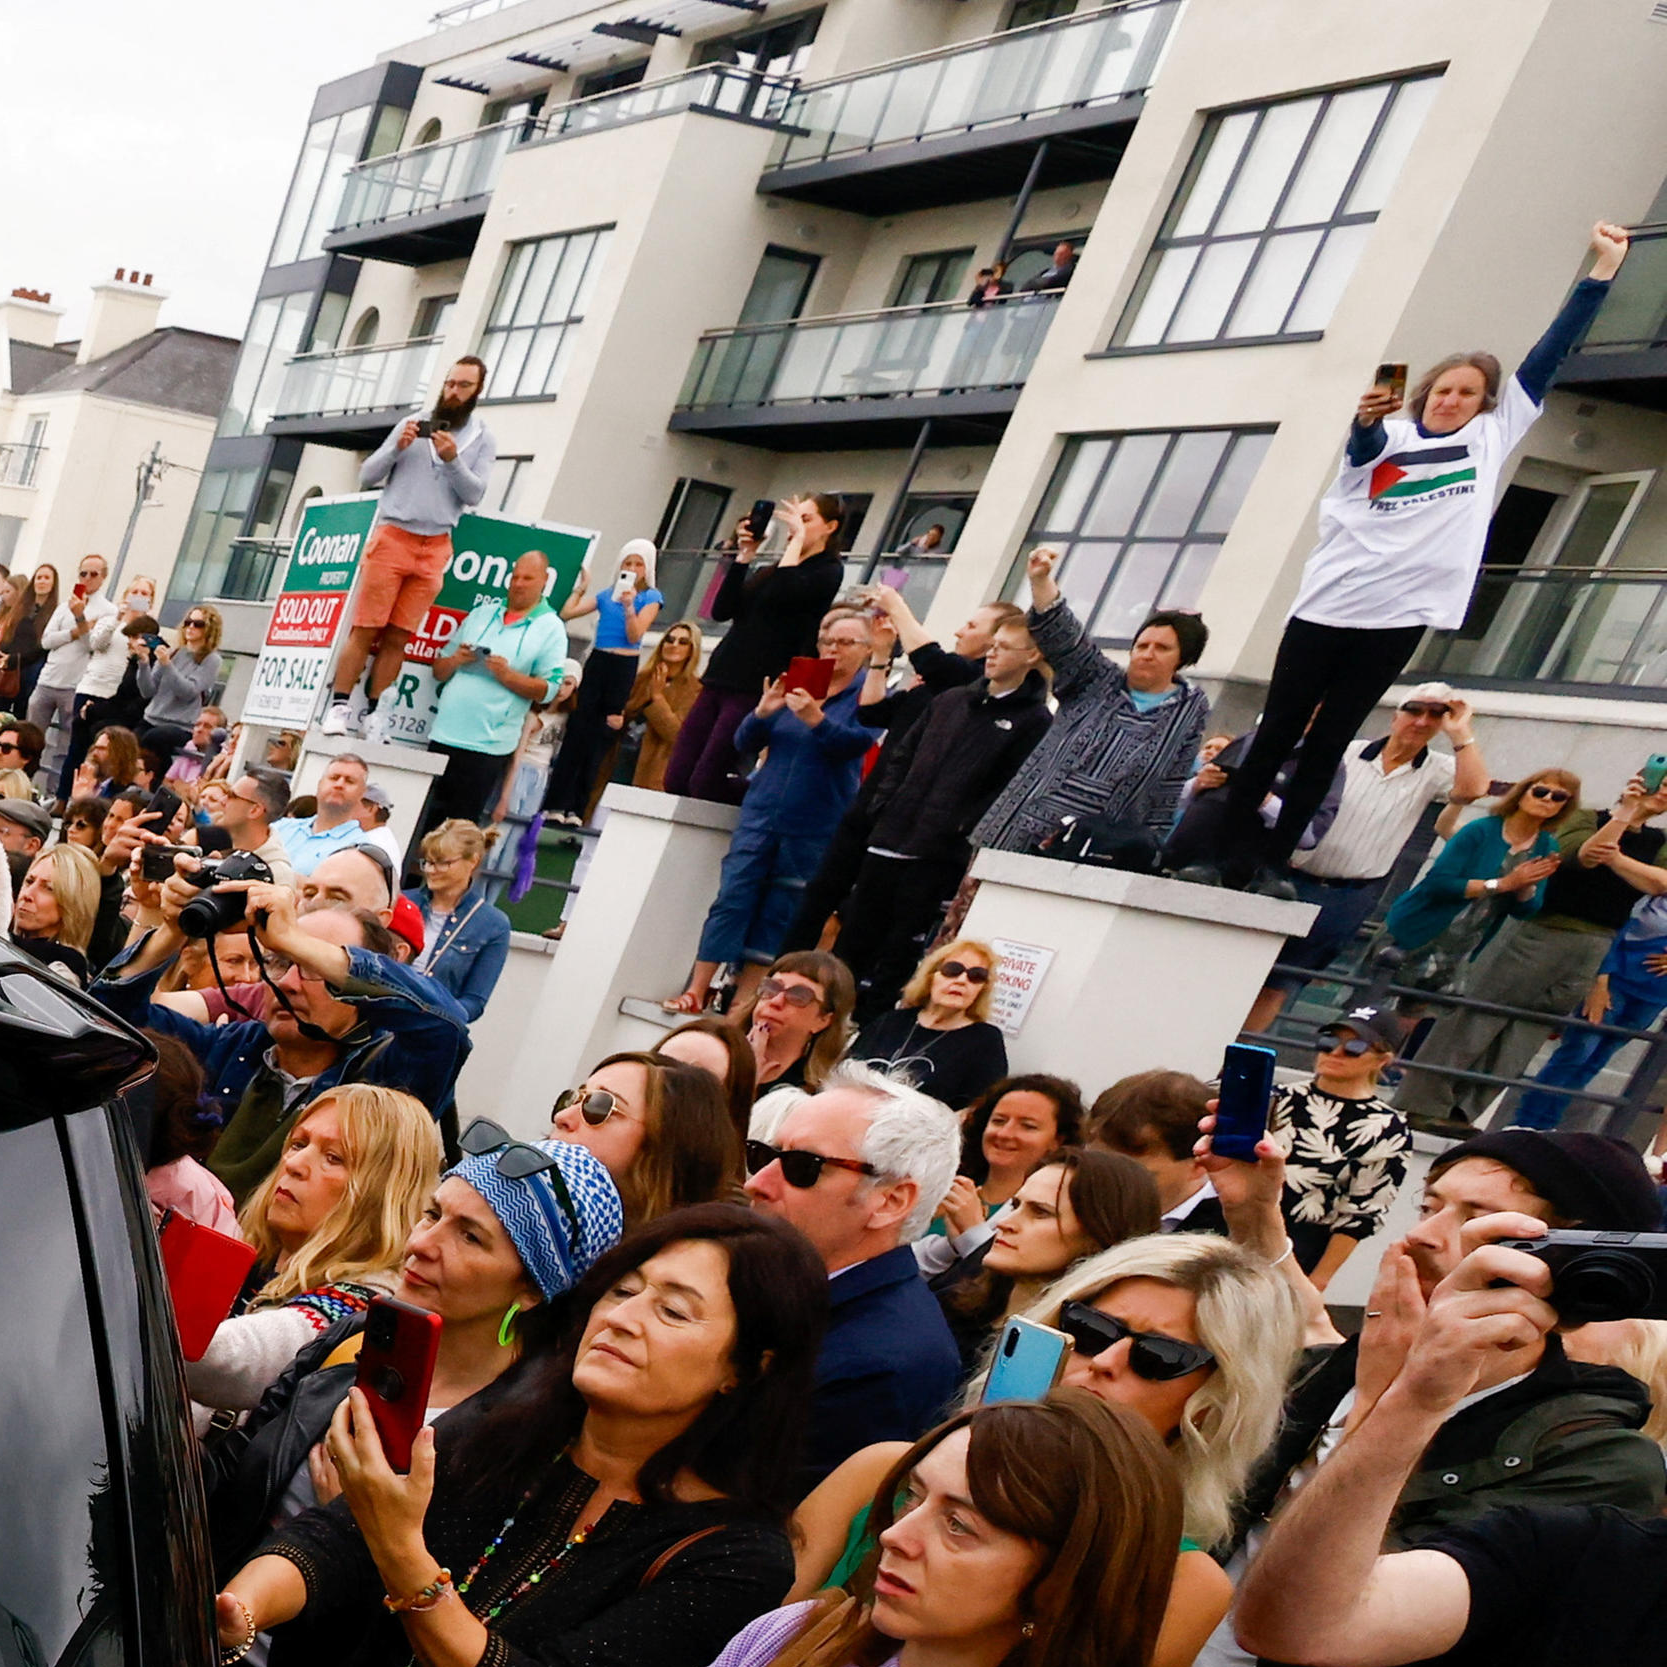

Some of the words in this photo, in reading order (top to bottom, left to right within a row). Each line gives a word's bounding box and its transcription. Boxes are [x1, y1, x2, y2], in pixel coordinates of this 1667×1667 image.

[1369, 500, 1398, 511] FREE
[1402, 484, 1475, 506] PALESTINE
[297, 527, 361, 566] Coonan
[276, 598, 308, 624] SOLD
[308, 598, 339, 624] OUT
[257, 657, 287, 688] FOR
[286, 658, 323, 691] SALE
[1001, 956, 1037, 975] RIVATE
[999, 972, 1032, 991] RKING
